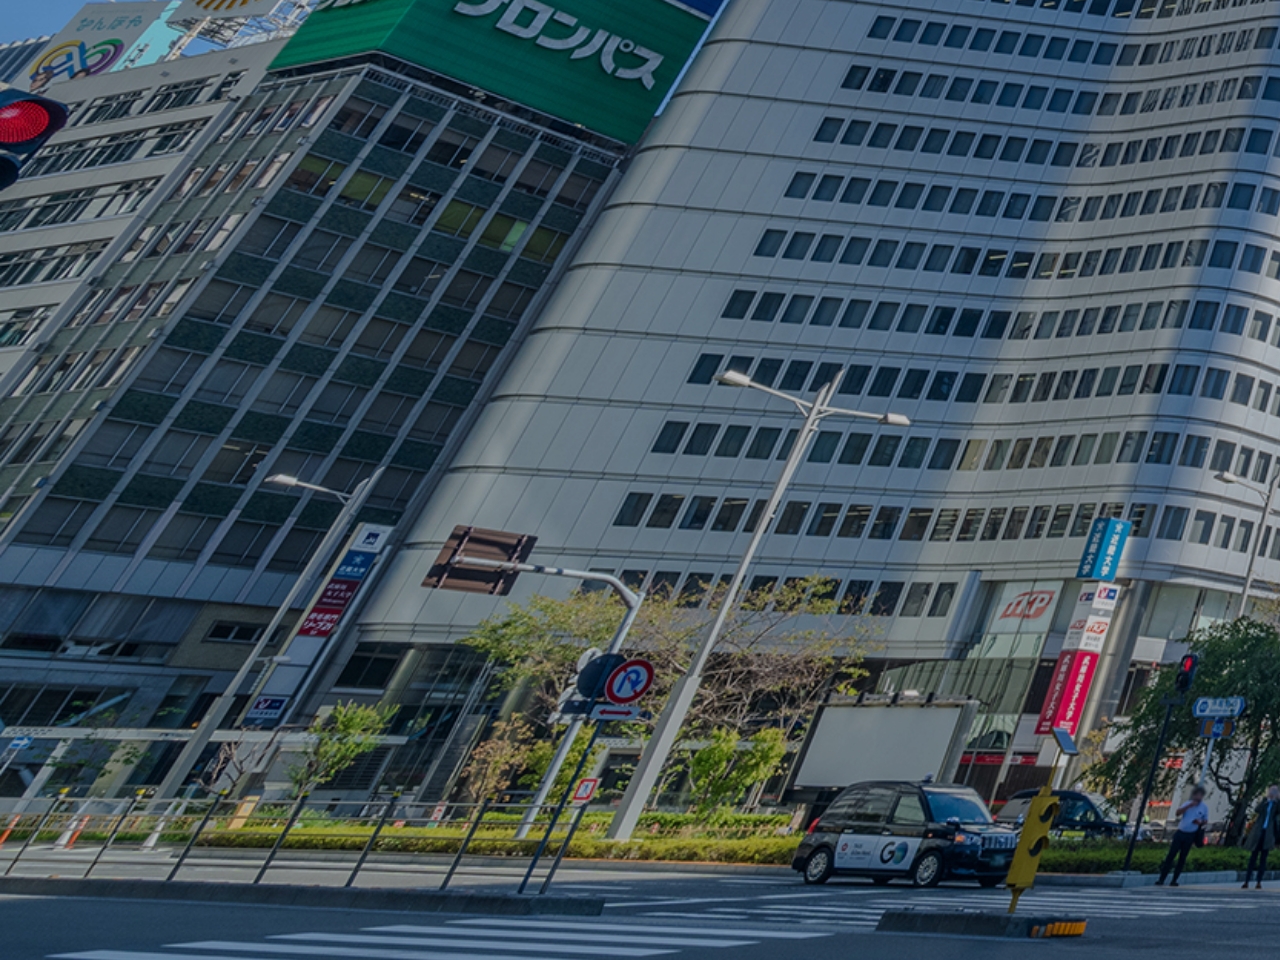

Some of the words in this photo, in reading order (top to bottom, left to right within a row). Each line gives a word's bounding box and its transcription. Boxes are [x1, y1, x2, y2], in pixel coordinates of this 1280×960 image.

[76, 15, 143, 32] なんぼや
[1002, 591, 1053, 617] TKP
[880, 841, 909, 865] GO
